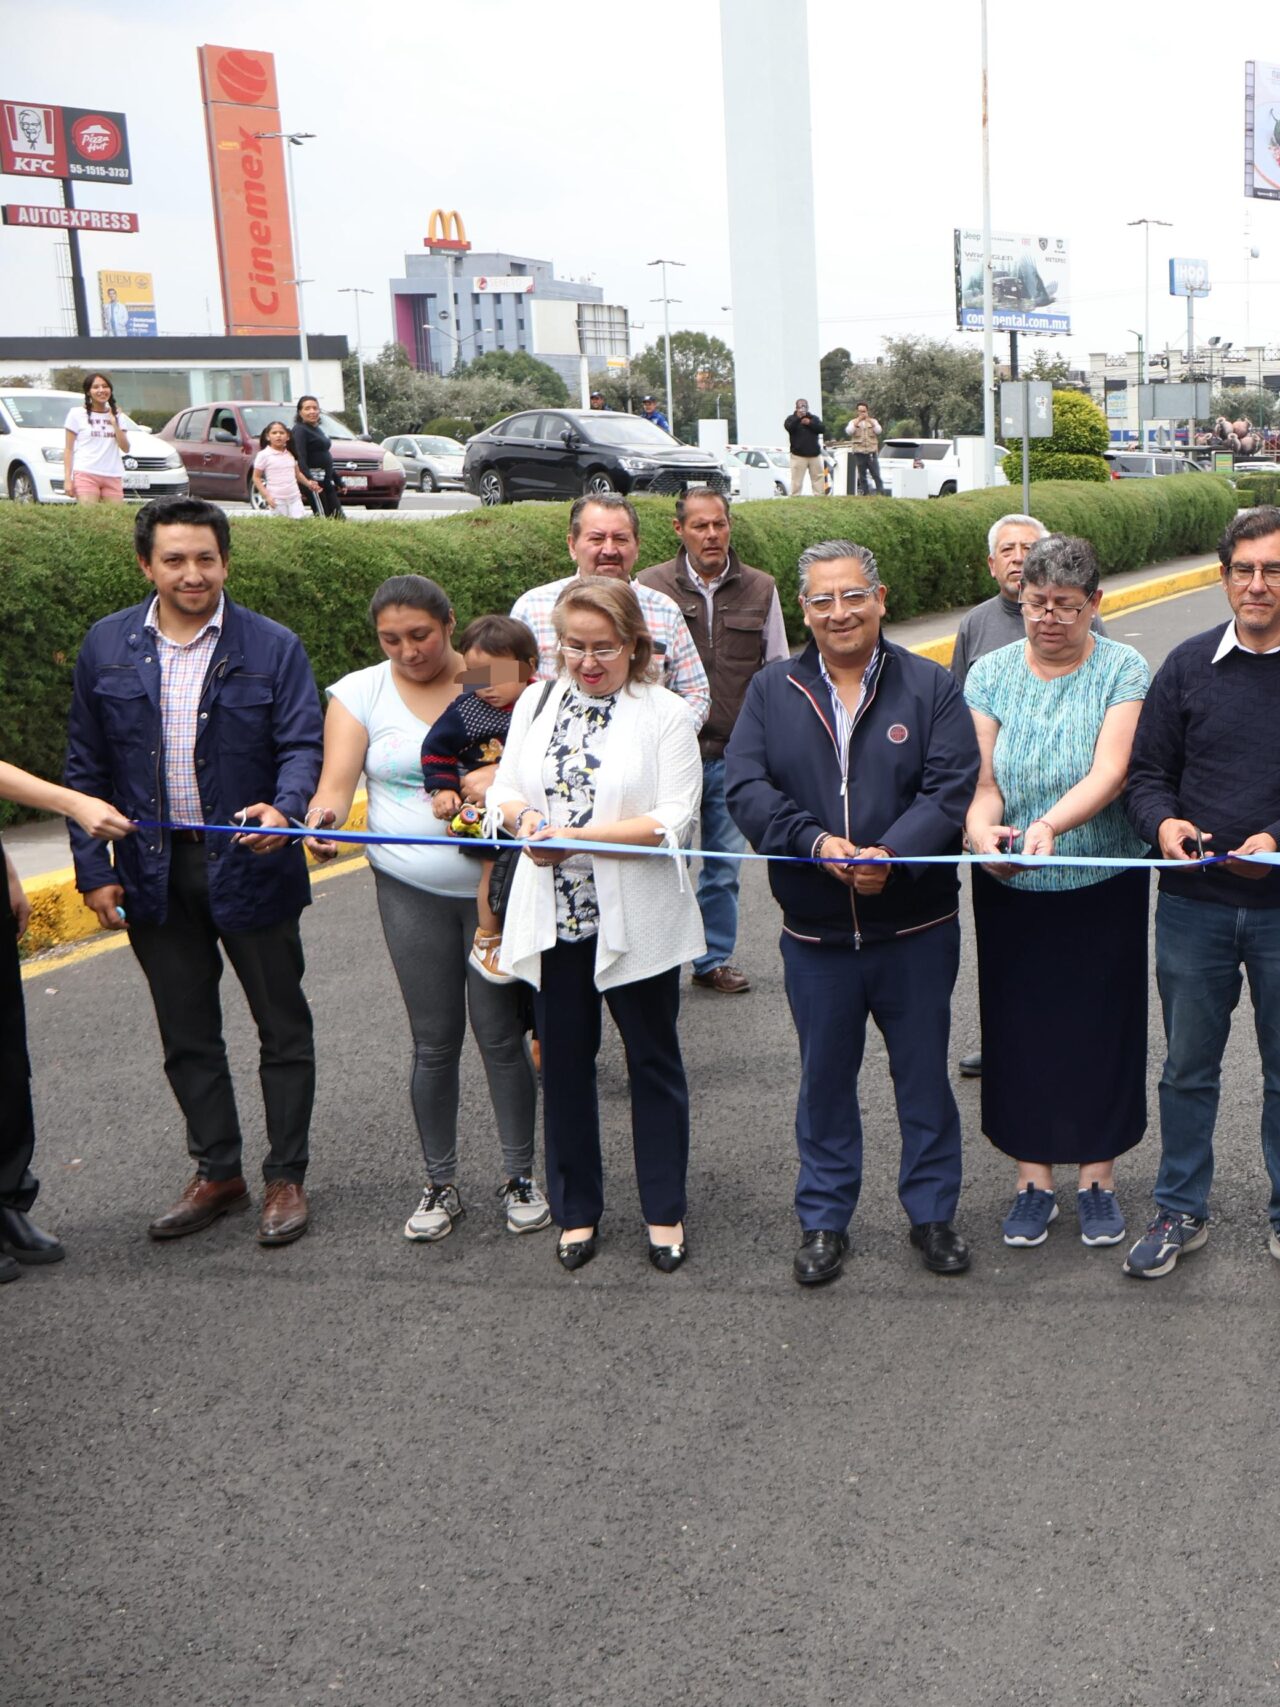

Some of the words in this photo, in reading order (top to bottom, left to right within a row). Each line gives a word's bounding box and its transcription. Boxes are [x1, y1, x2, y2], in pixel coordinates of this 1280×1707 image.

[81, 134, 110, 146] Pizza
[87, 143, 109, 153] Hut
[13, 157, 55, 173] KFC
[69, 163, 129, 178] 55-1515-3737
[17, 207, 131, 230] AUTOEXPRESS
[239, 126, 280, 315] Cinemex
[963, 231, 981, 241] Jeep
[965, 250, 1014, 261] WRAGLER
[966, 313, 1068, 330] connental.com.mx
